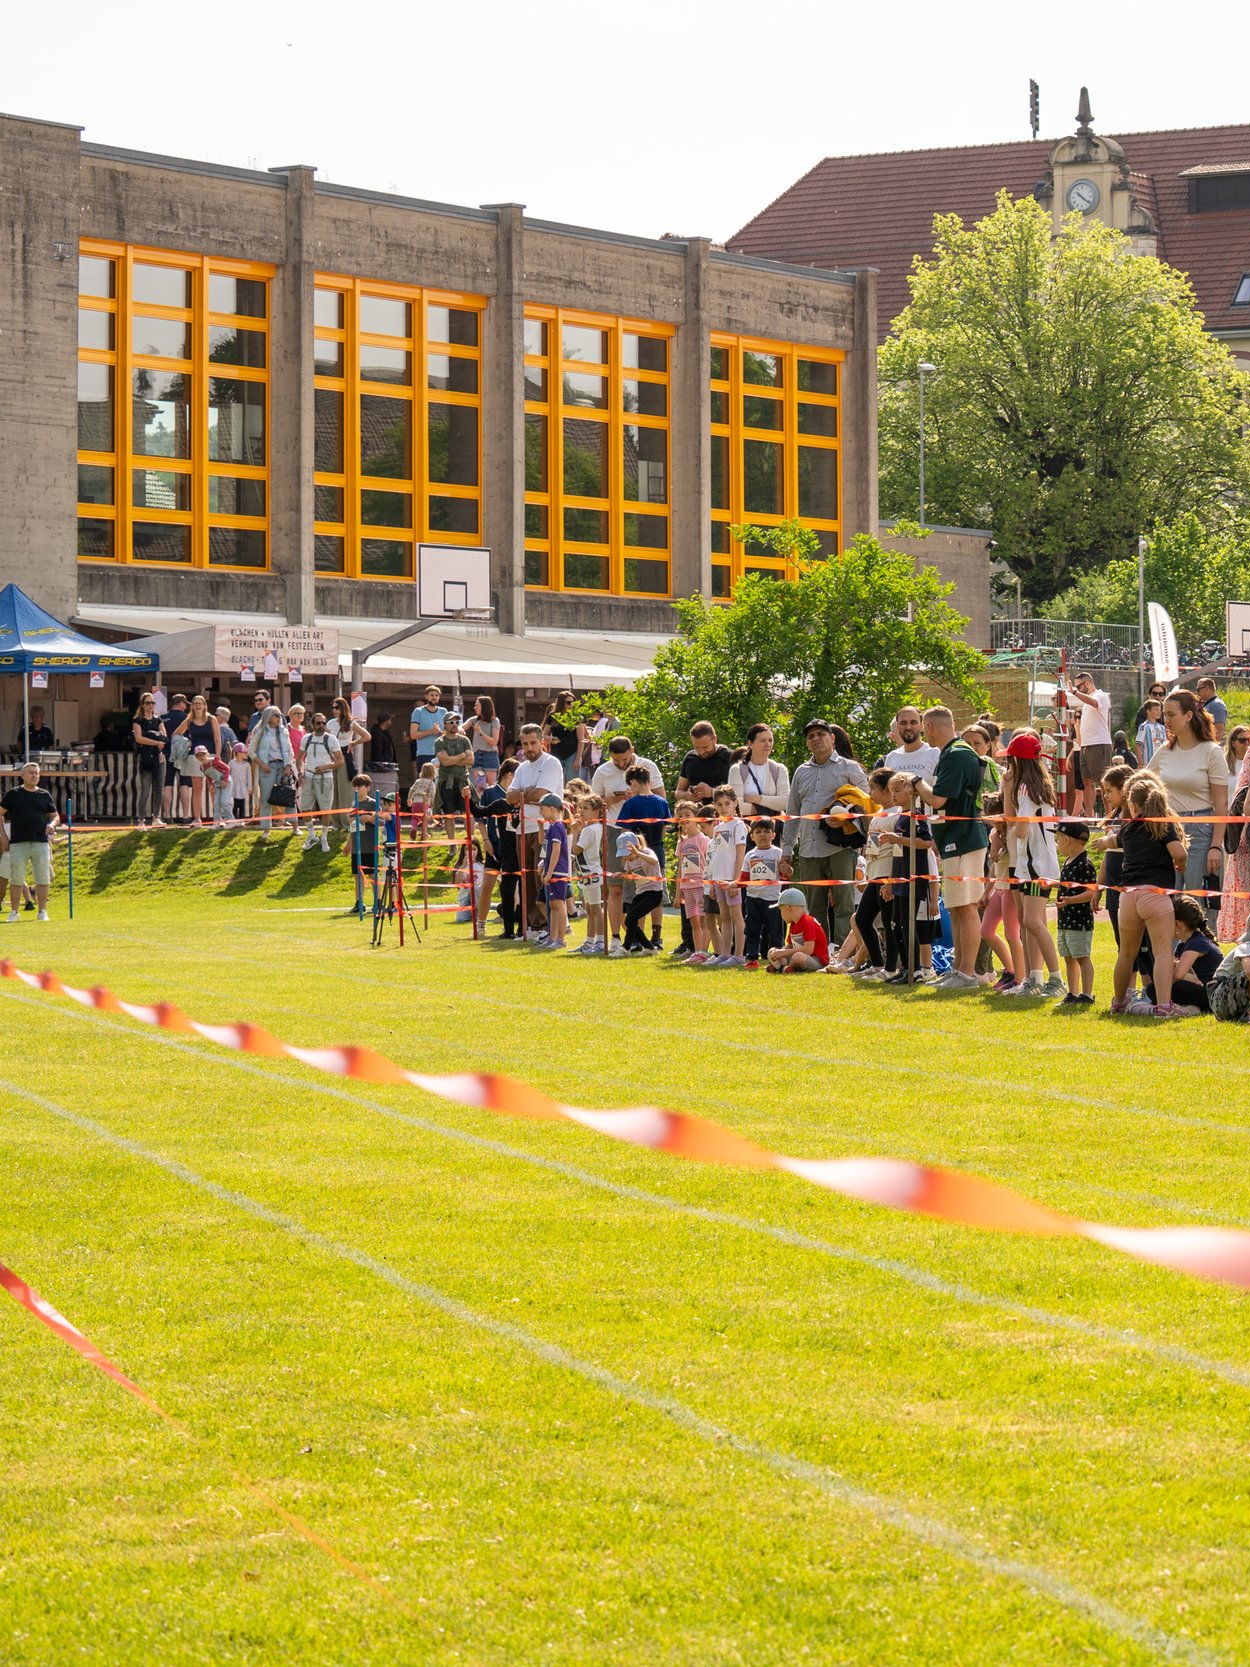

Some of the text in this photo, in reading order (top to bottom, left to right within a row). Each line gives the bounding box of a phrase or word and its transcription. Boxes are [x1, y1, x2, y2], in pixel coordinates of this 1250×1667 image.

[230, 629, 259, 637] BLACHEN
[292, 630, 311, 640] ALLER
[312, 631, 324, 640] ART
[231, 640, 325, 652] VERMIETUNG VON FESTZELTEN
[32, 656, 152, 666] SHERCO SHERCO
[752, 866, 767, 874] 402
